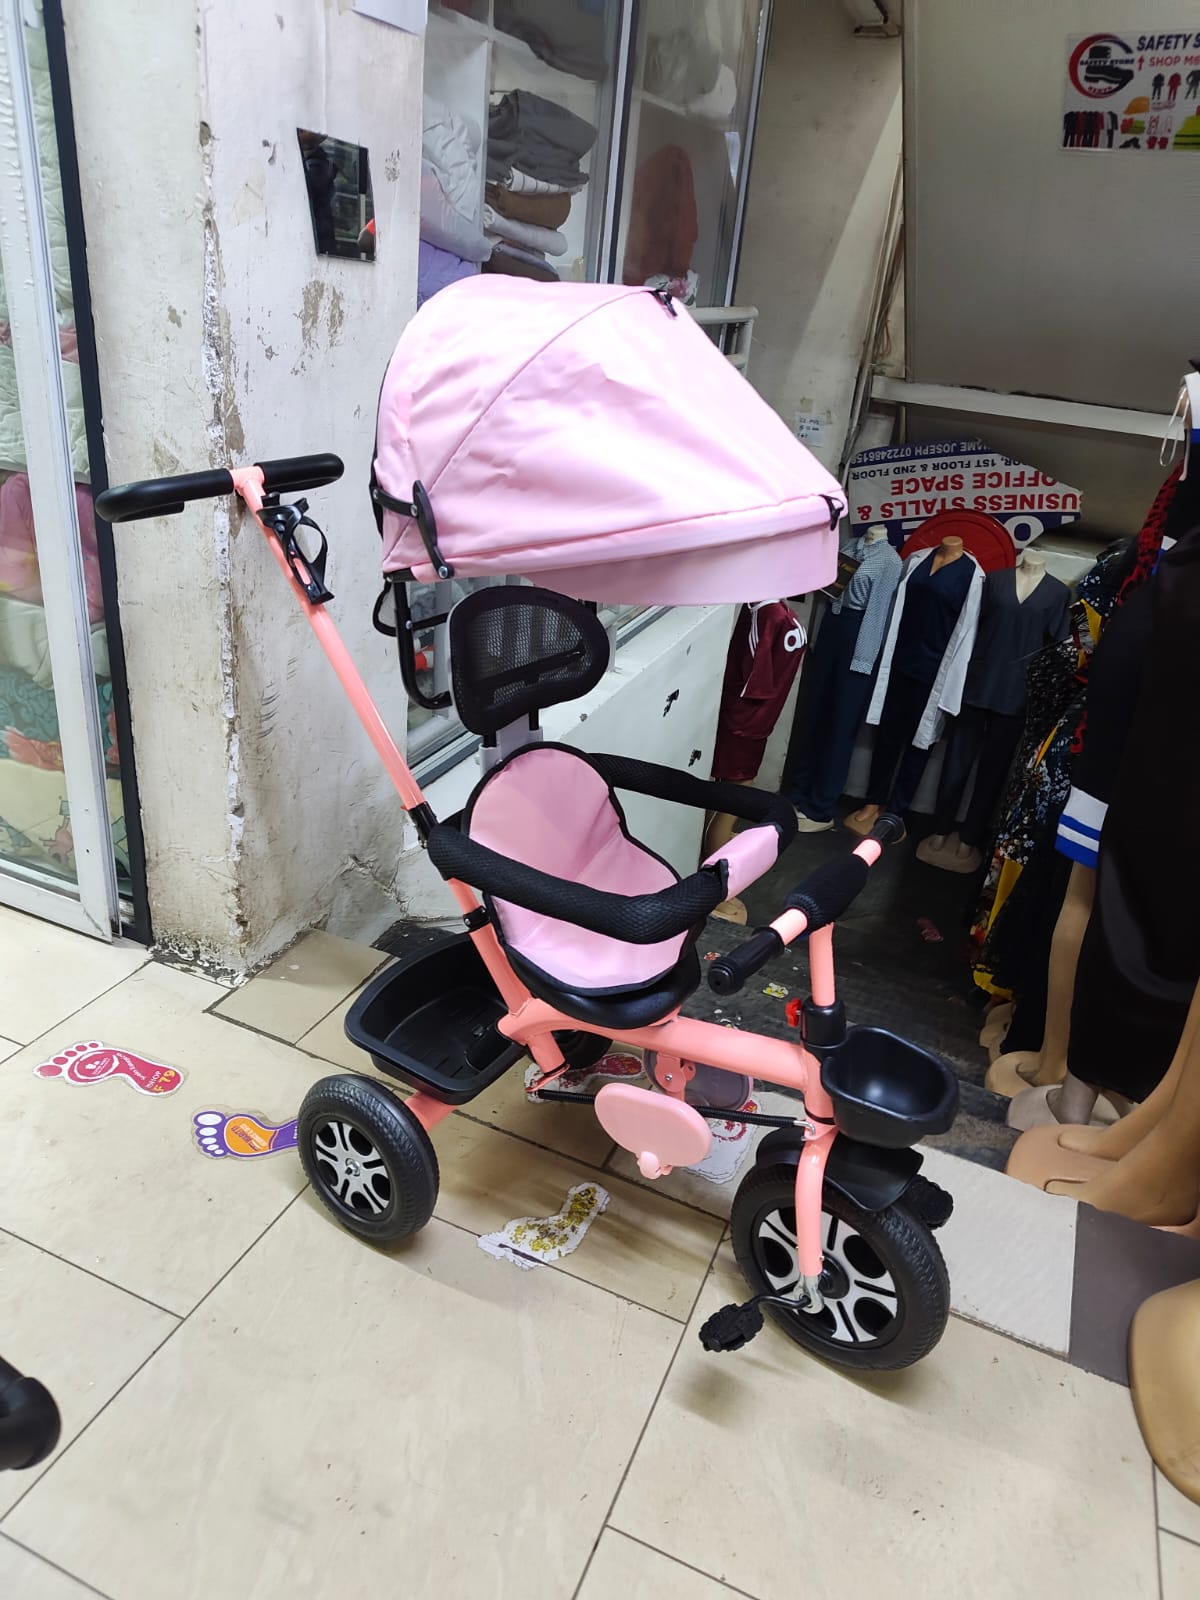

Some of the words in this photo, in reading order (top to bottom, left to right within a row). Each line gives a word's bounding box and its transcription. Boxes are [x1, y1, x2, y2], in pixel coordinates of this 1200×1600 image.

[1137, 34, 1192, 51] SAFETY
[1148, 55, 1182, 67] SHOP
[915, 442, 957, 457] JOSEPH
[893, 465, 916, 475] 2ND
[920, 463, 928, 472] &
[932, 460, 971, 471] FLOOR
[974, 459, 997, 468] 1ST
[852, 467, 889, 480] FLOOR
[972, 471, 1057, 489] OFFICE
[891, 473, 964, 496] SPACE
[880, 496, 965, 518] STALLS
[973, 493, 1083, 511] USINESS
[857, 505, 872, 520] &
[145, 1070, 161, 1088] SHOP
